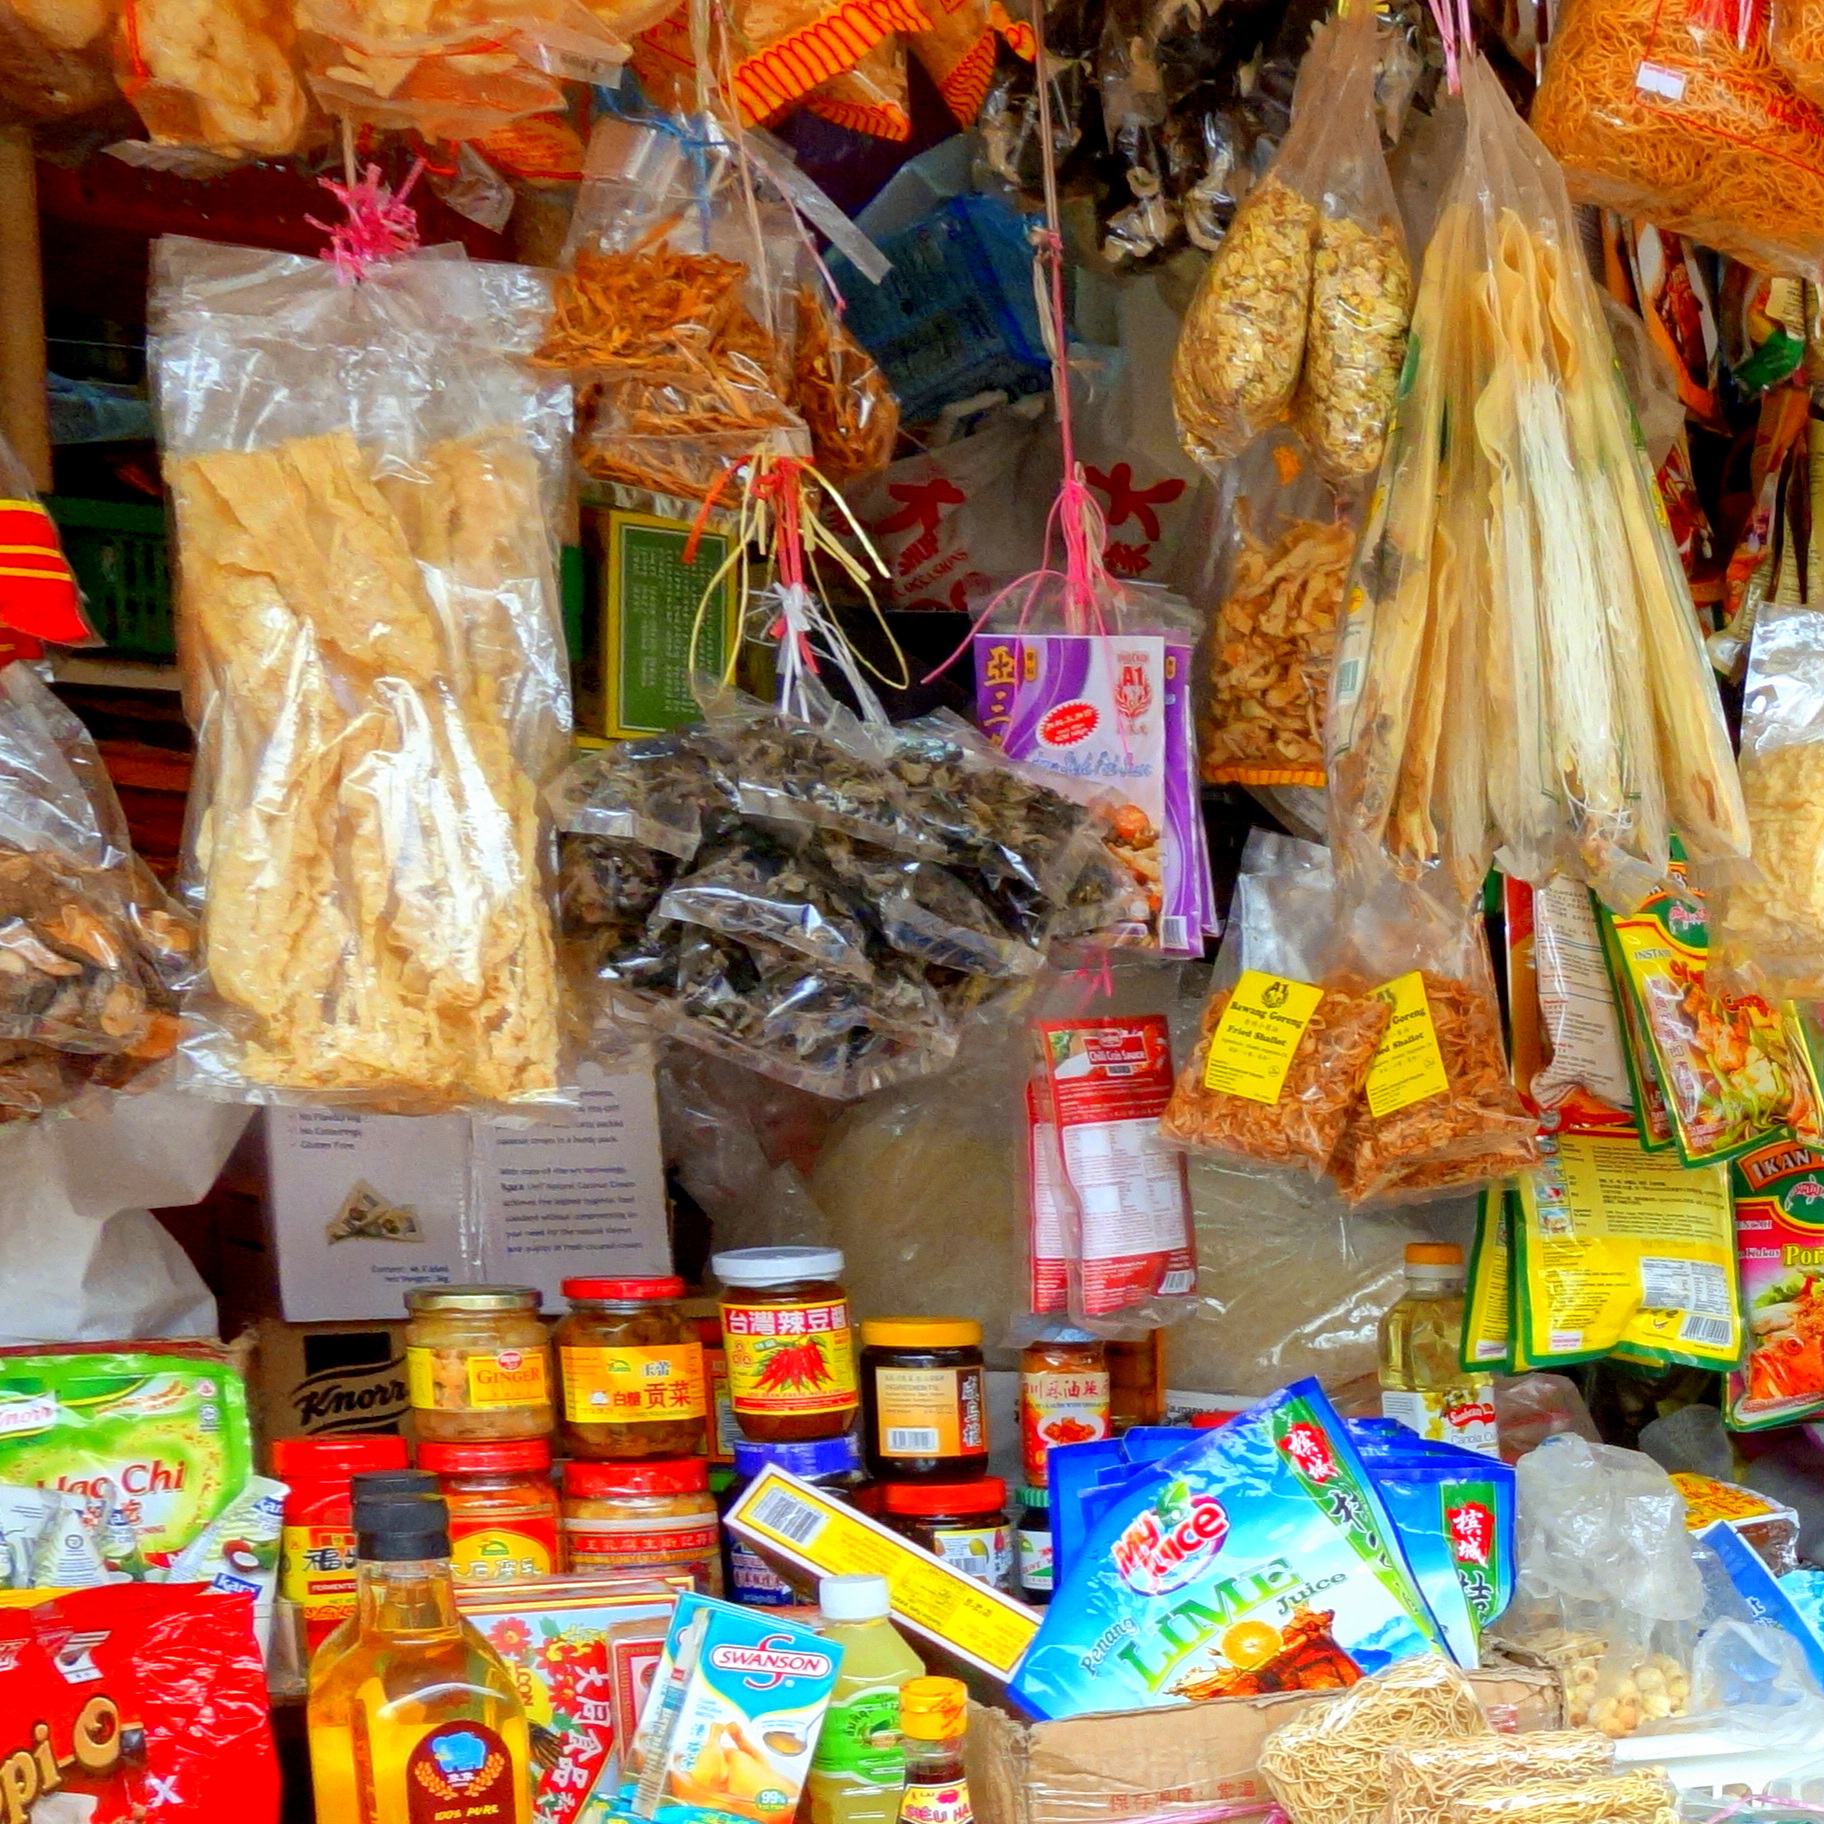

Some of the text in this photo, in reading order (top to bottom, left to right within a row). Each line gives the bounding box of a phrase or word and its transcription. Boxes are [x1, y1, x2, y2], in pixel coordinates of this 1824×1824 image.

[1121, 666, 1143, 687] A1
[1230, 1001, 1305, 1029] Bawang Goreng
[1392, 1007, 1426, 1025] Goreng
[1226, 1024, 1251, 1038] Fried
[1751, 1149, 1813, 1182] IKAN
[477, 1367, 542, 1386] GINGER
[0, 1405, 54, 1426] norr
[121, 1459, 187, 1495] Chi
[1276, 1571, 1348, 1617] Juice
[1116, 1556, 1302, 1693] LIME
[1079, 1616, 1140, 1678] Penang
[718, 1650, 822, 1672] SWANSON
[467, 1804, 500, 1818] PURE
